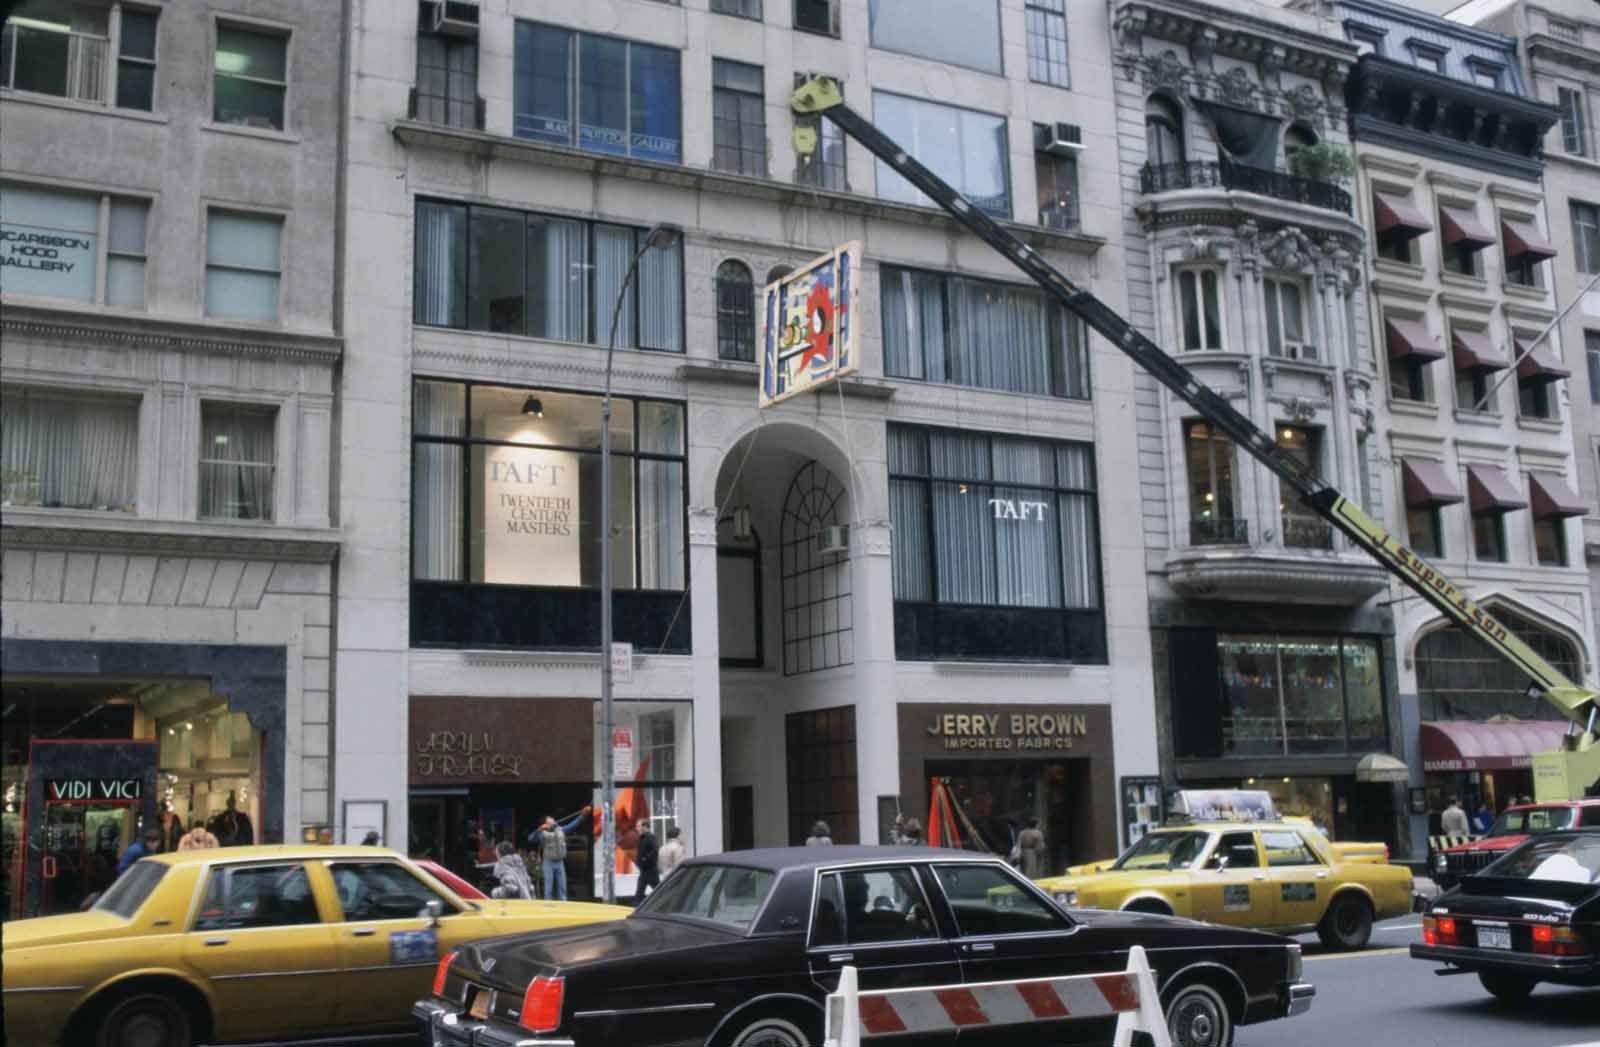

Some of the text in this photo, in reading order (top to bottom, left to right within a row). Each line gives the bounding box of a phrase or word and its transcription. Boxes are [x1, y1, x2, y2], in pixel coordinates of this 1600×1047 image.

[11, 244, 58, 259] HOOD
[489, 460, 564, 486] TAFT
[499, 493, 571, 510] TWENTIETH
[988, 499, 1048, 521] TAFT
[511, 508, 570, 523] CENTURY
[506, 521, 571, 536] MASTERS
[928, 714, 1088, 735] JERRY BROWN
[944, 737, 1073, 749] IMPORTED FABRICS
[52, 780, 140, 799] VIDI VICI
